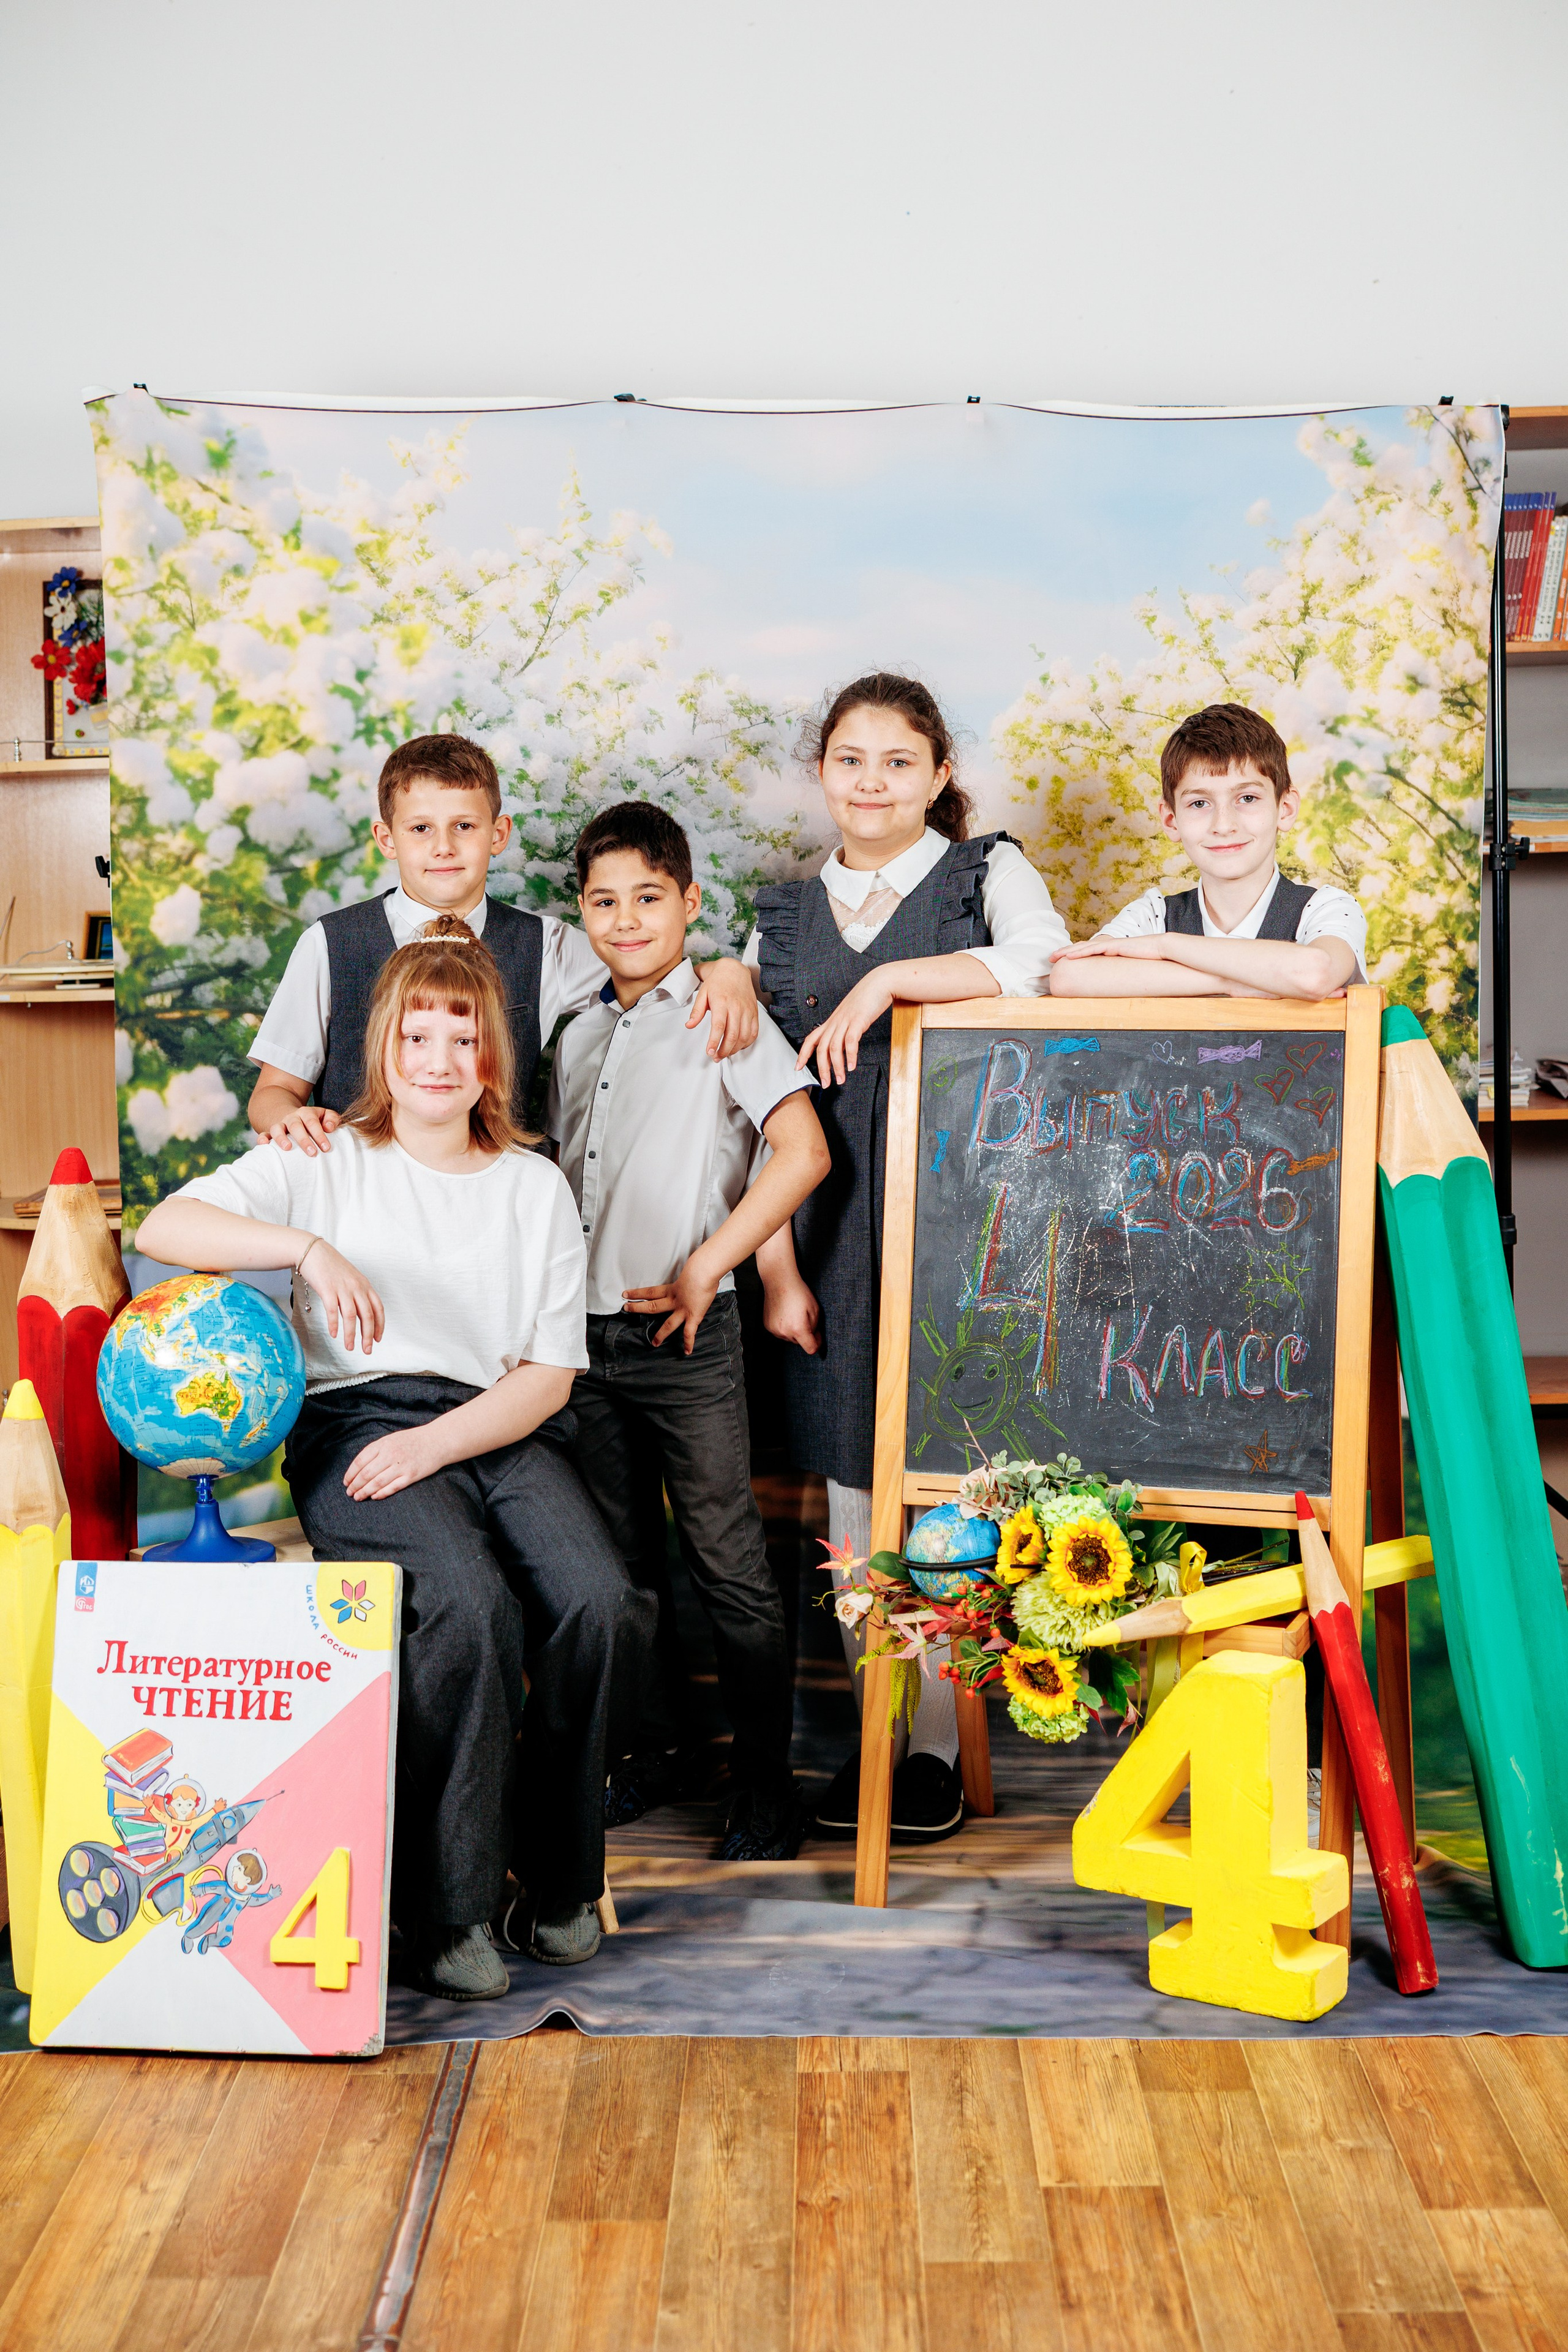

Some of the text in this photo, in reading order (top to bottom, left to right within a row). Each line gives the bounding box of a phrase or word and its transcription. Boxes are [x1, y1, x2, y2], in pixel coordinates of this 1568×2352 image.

[968, 1038, 1243, 1158] Выпуск
[1104, 1147, 1312, 1234] 2026
[957, 1181, 1066, 1396] 4
[97, 1640, 332, 1686] Литературное
[132, 1686, 292, 1721] ЧТЕНИЕ
[1072, 1649, 1349, 2022] 4
[270, 1849, 360, 1990] 4
